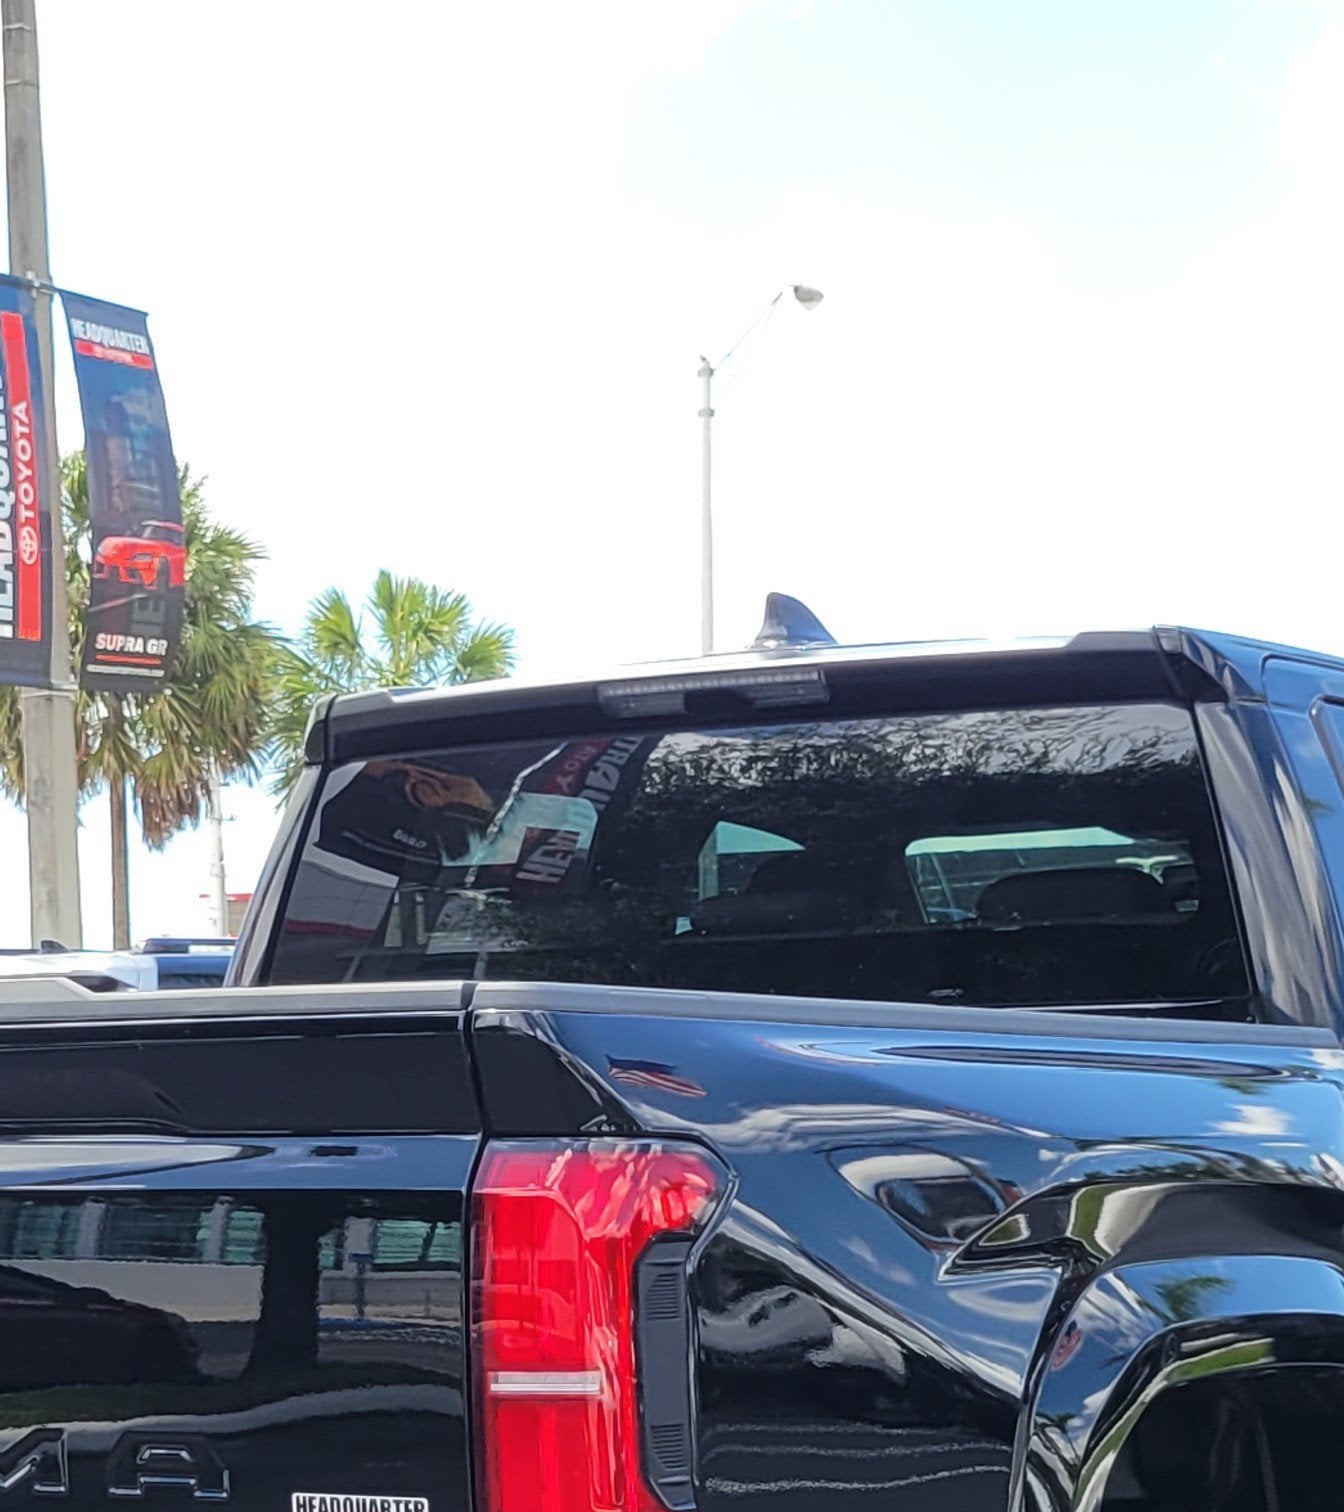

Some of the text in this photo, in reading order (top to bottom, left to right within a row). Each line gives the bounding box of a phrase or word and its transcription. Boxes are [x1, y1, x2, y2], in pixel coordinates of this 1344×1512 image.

[13, 401, 35, 524] TOYOTA
[96, 633, 168, 656] SUPRA GR
